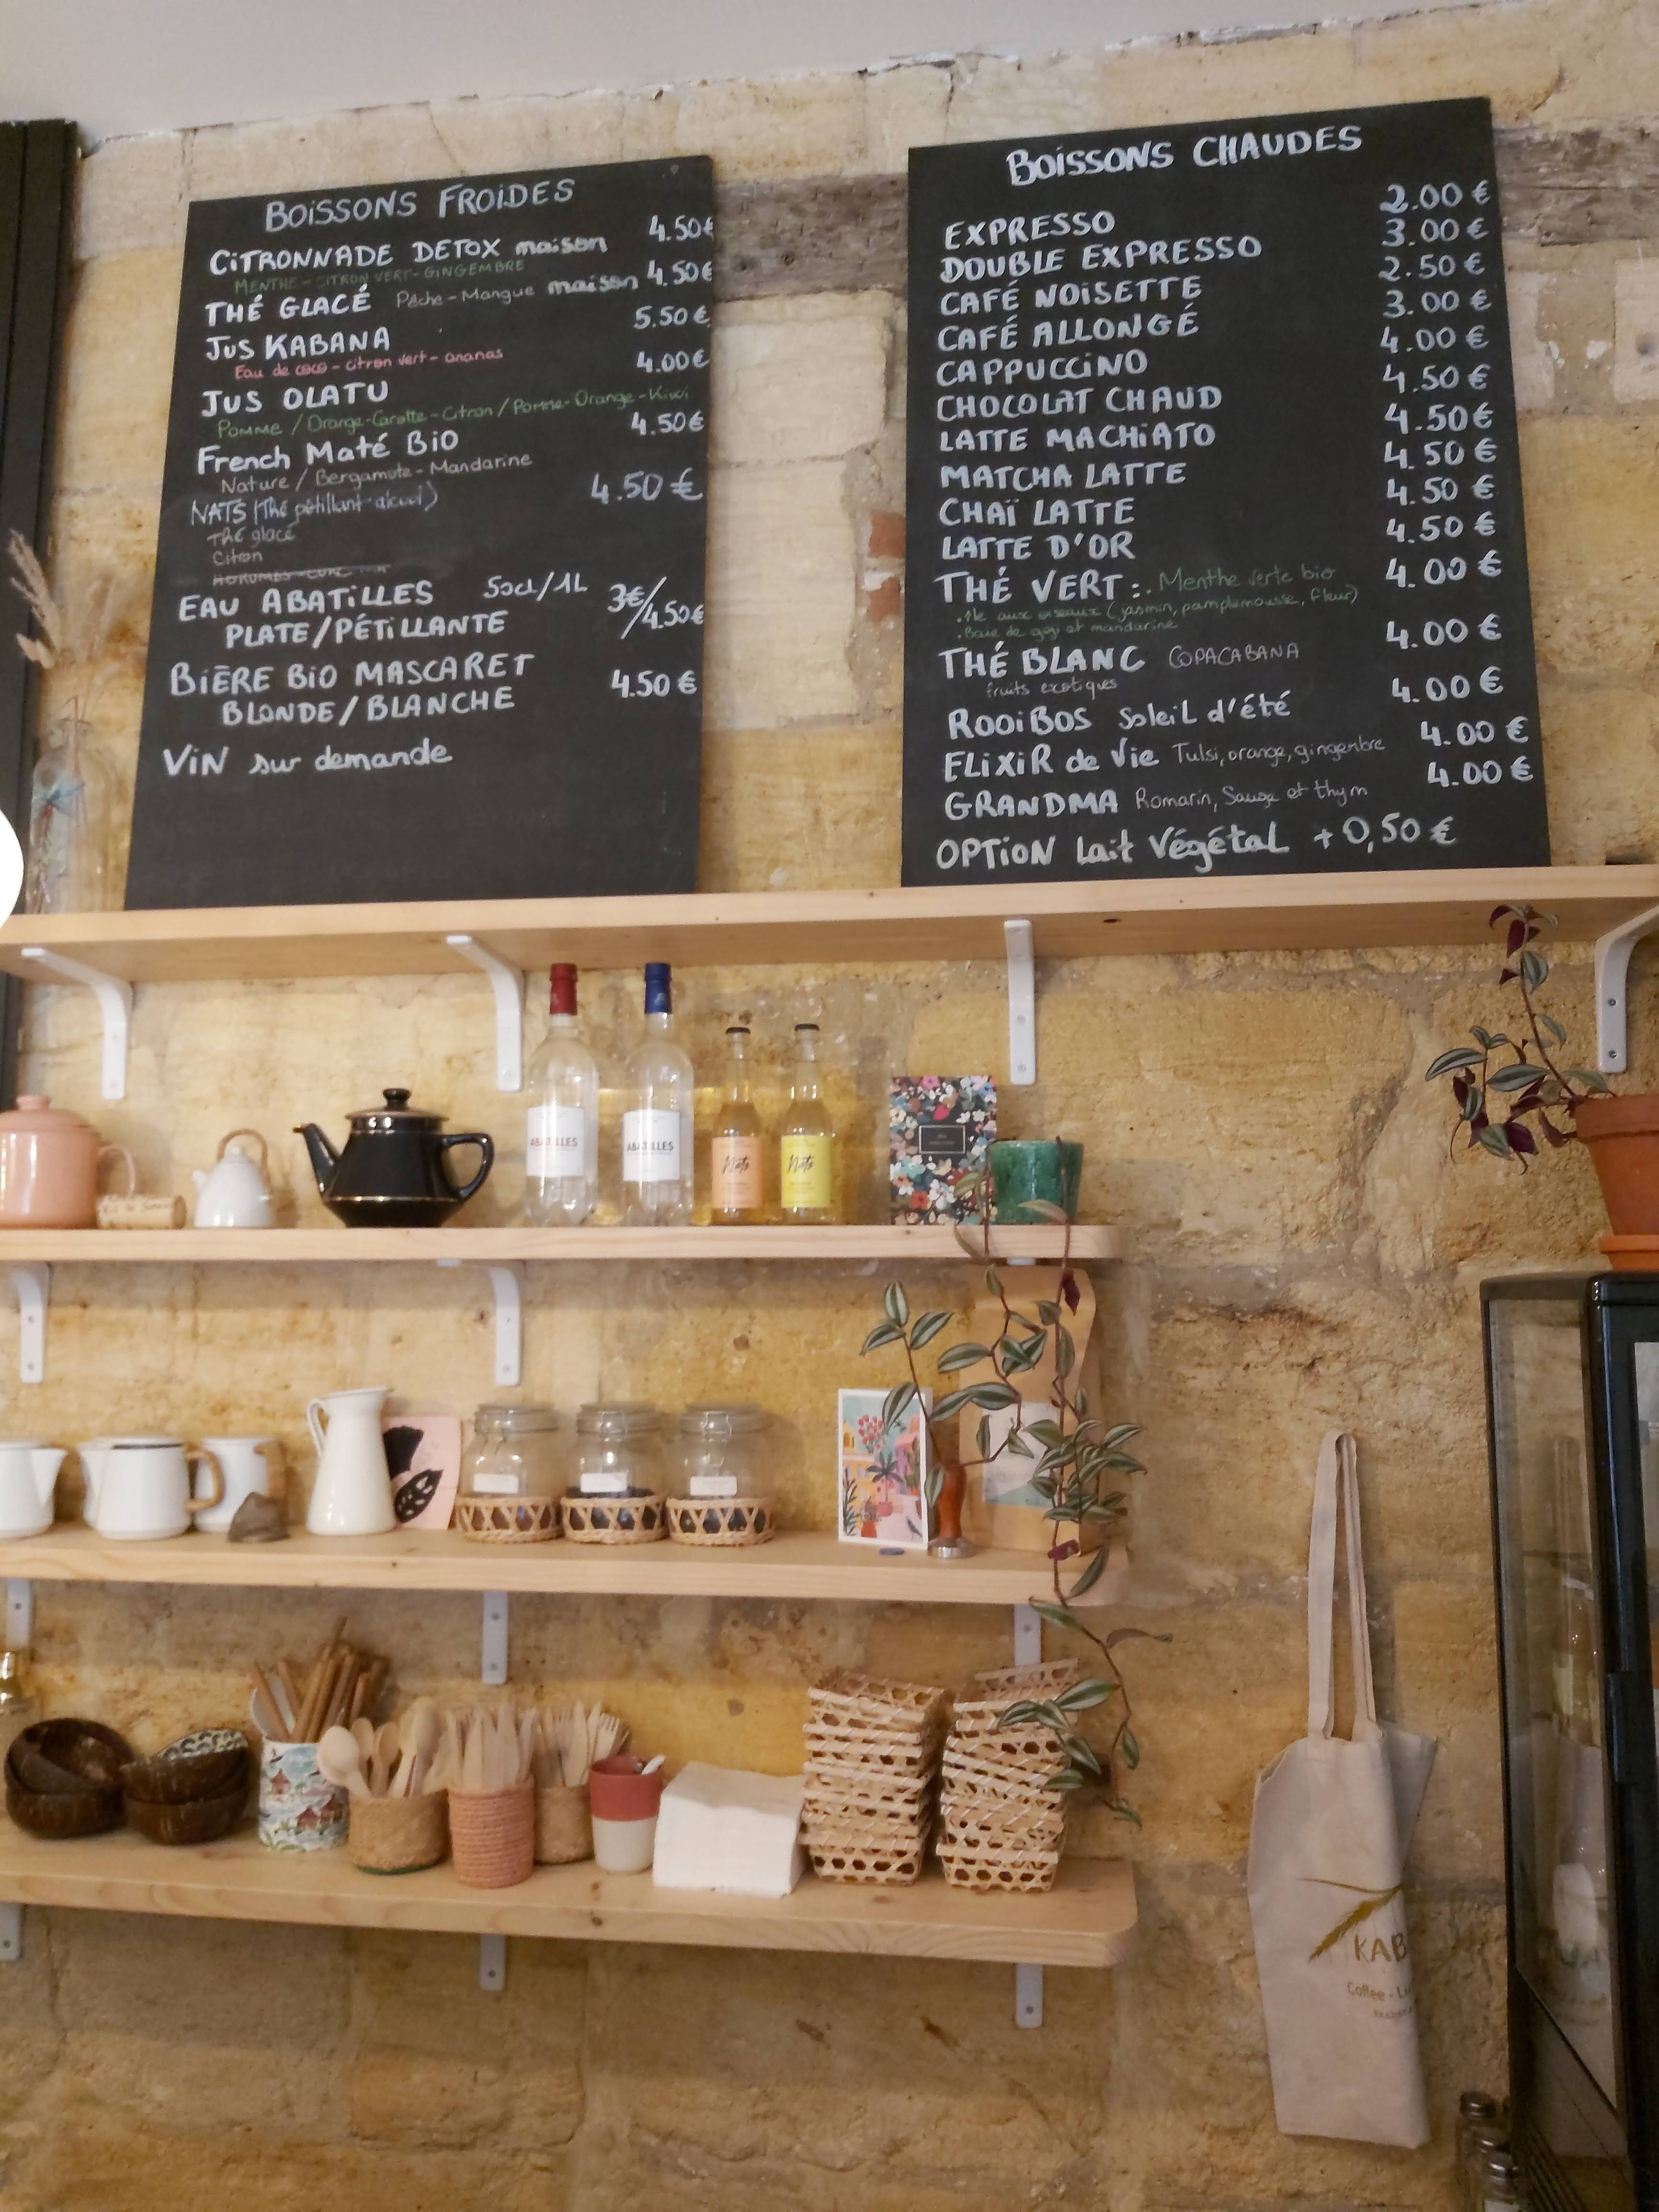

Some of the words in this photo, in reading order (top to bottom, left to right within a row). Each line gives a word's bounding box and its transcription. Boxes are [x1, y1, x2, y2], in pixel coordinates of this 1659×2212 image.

[1193, 125, 1363, 167] CHAUDES
[944, 210, 1116, 251] EXPRESSO
[412, 238, 501, 263] DETOX
[515, 236, 608, 257] maison
[939, 247, 1066, 284] DOUBLE
[1081, 234, 1263, 270] EXPRESSO
[205, 294, 264, 328] THÉ
[279, 283, 372, 319] GLACÉ
[547, 274, 639, 296] maison
[940, 279, 1020, 317] CAFÉ
[264, 326, 390, 361] KABANA
[937, 313, 1019, 352] CAFÉ
[1033, 302, 1200, 349] ALLONGÉ
[235, 364, 264, 380] Eau
[273, 361, 290, 377] de
[444, 348, 504, 364] ananas
[283, 380, 389, 411] OLATU
[936, 387, 1095, 422] CHOCOLAT
[1104, 385, 1223, 414] CHAUD
[197, 443, 291, 476] French
[306, 432, 391, 467] Maté
[939, 427, 1029, 453] LATTE
[221, 477, 290, 495] Nature
[430, 453, 534, 475] Mandarine
[940, 463, 1073, 492] MATCHA
[1084, 461, 1188, 490] LATTE
[191, 498, 247, 526] NATS
[1032, 497, 1136, 527] LATTE
[942, 535, 1033, 560] LATTE
[933, 565, 1012, 605] THÉ
[178, 594, 239, 622] EAU
[355, 651, 535, 687] MASCARET
[937, 640, 1010, 680] THÉ
[1021, 645, 1147, 676] BLANC
[315, 737, 453, 771] demande
[1065, 747, 1101, 774] de
[944, 789, 1119, 821] GRANDMA
